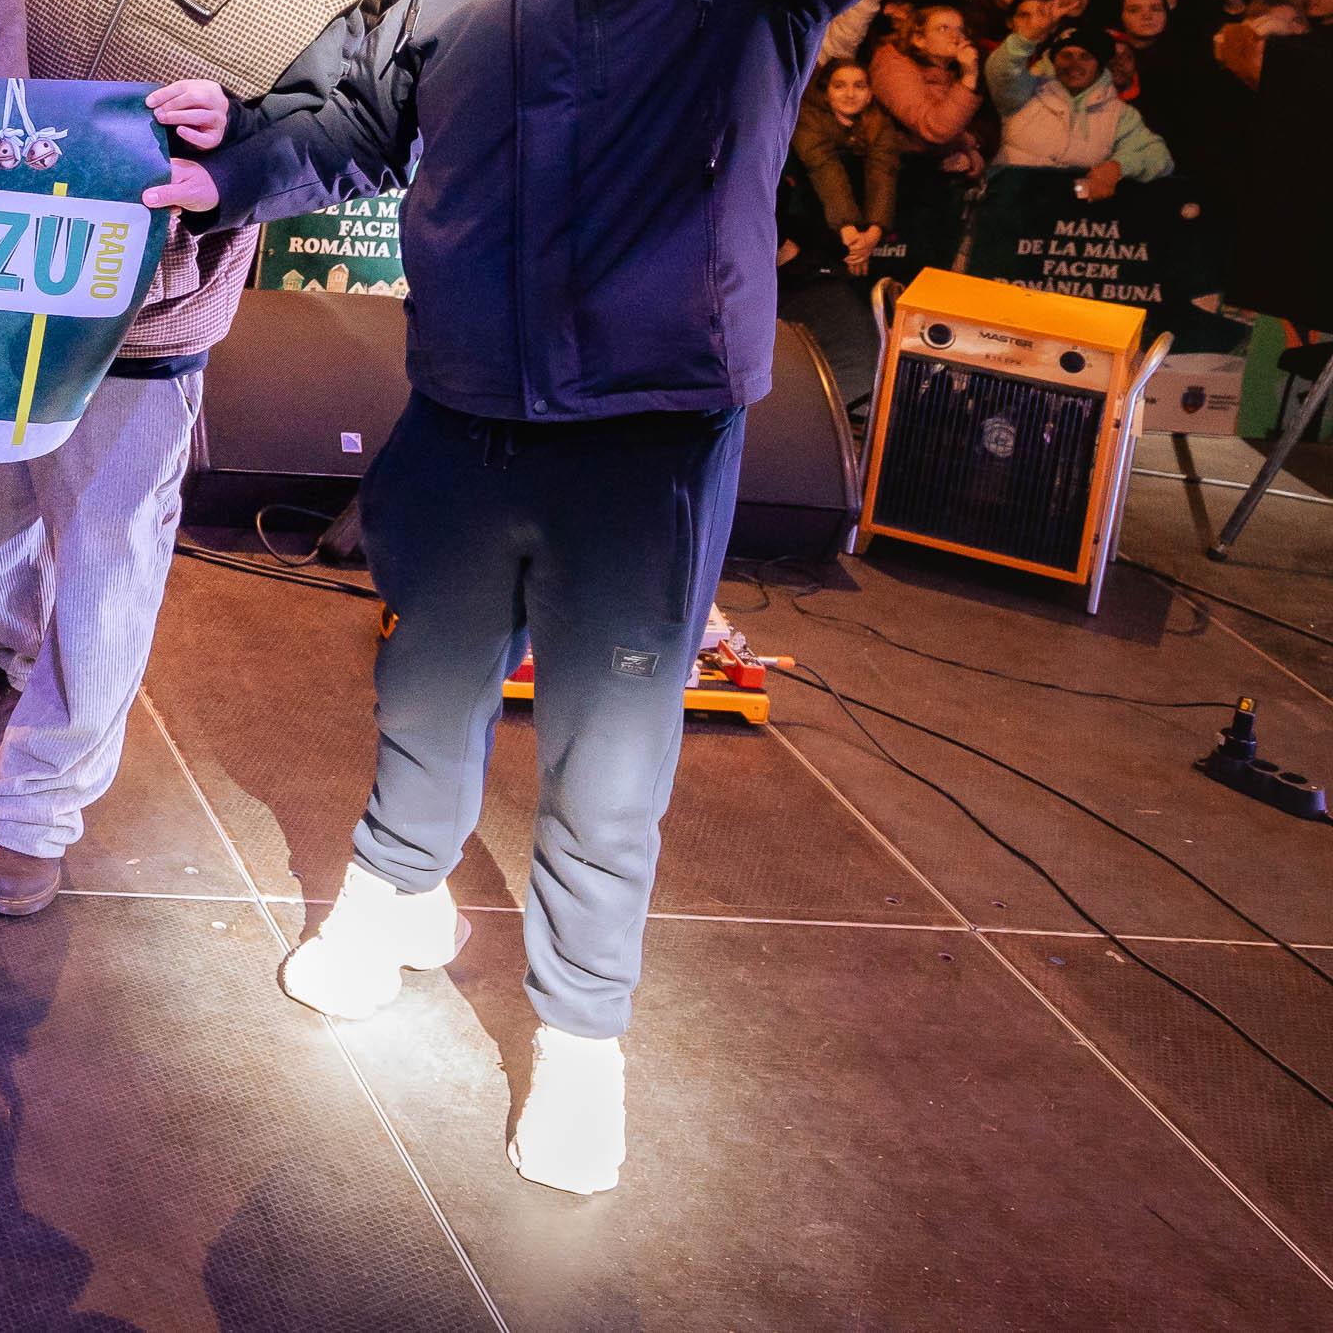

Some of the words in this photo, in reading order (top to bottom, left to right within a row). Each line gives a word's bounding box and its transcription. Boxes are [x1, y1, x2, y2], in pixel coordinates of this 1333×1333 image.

[344, 200, 372, 216] LA
[287, 236, 391, 258] ROMÂNIA
[1017, 238, 1044, 255] DE
[1048, 239, 1077, 257] LA
[89, 221, 130, 300] RADIO
[1043, 259, 1120, 280] FACEM
[979, 331, 1034, 349] MASTER
